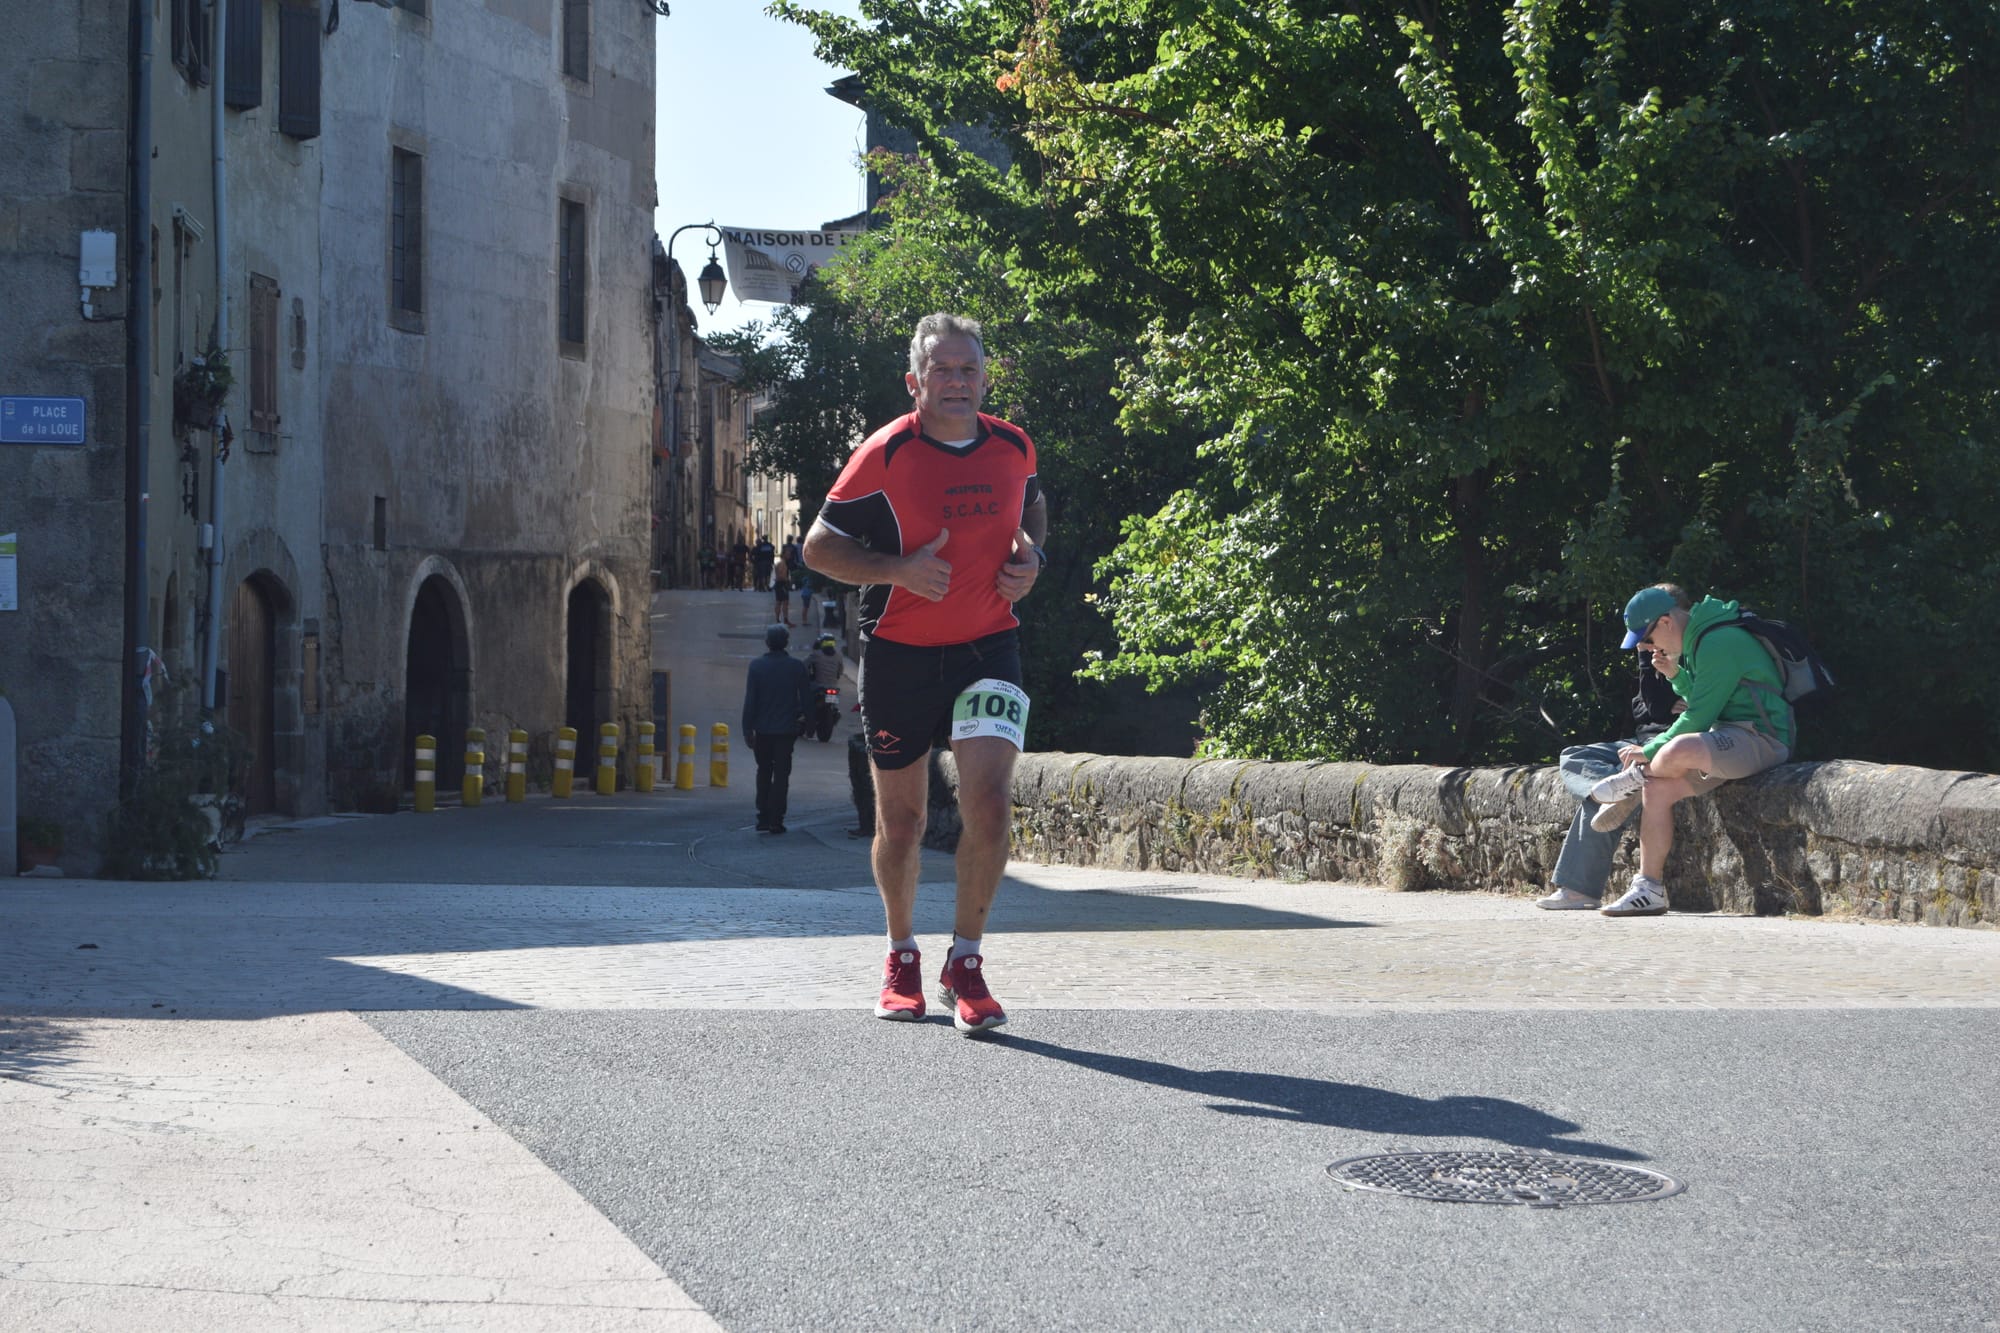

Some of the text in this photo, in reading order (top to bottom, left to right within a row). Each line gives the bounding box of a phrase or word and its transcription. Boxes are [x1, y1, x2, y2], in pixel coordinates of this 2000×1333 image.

[727, 231, 803, 246] MAISON
[810, 233, 835, 246] DE
[33, 406, 67, 418] PLACE
[22, 424, 79, 435] de la LOUE
[966, 693, 1021, 725] 108
